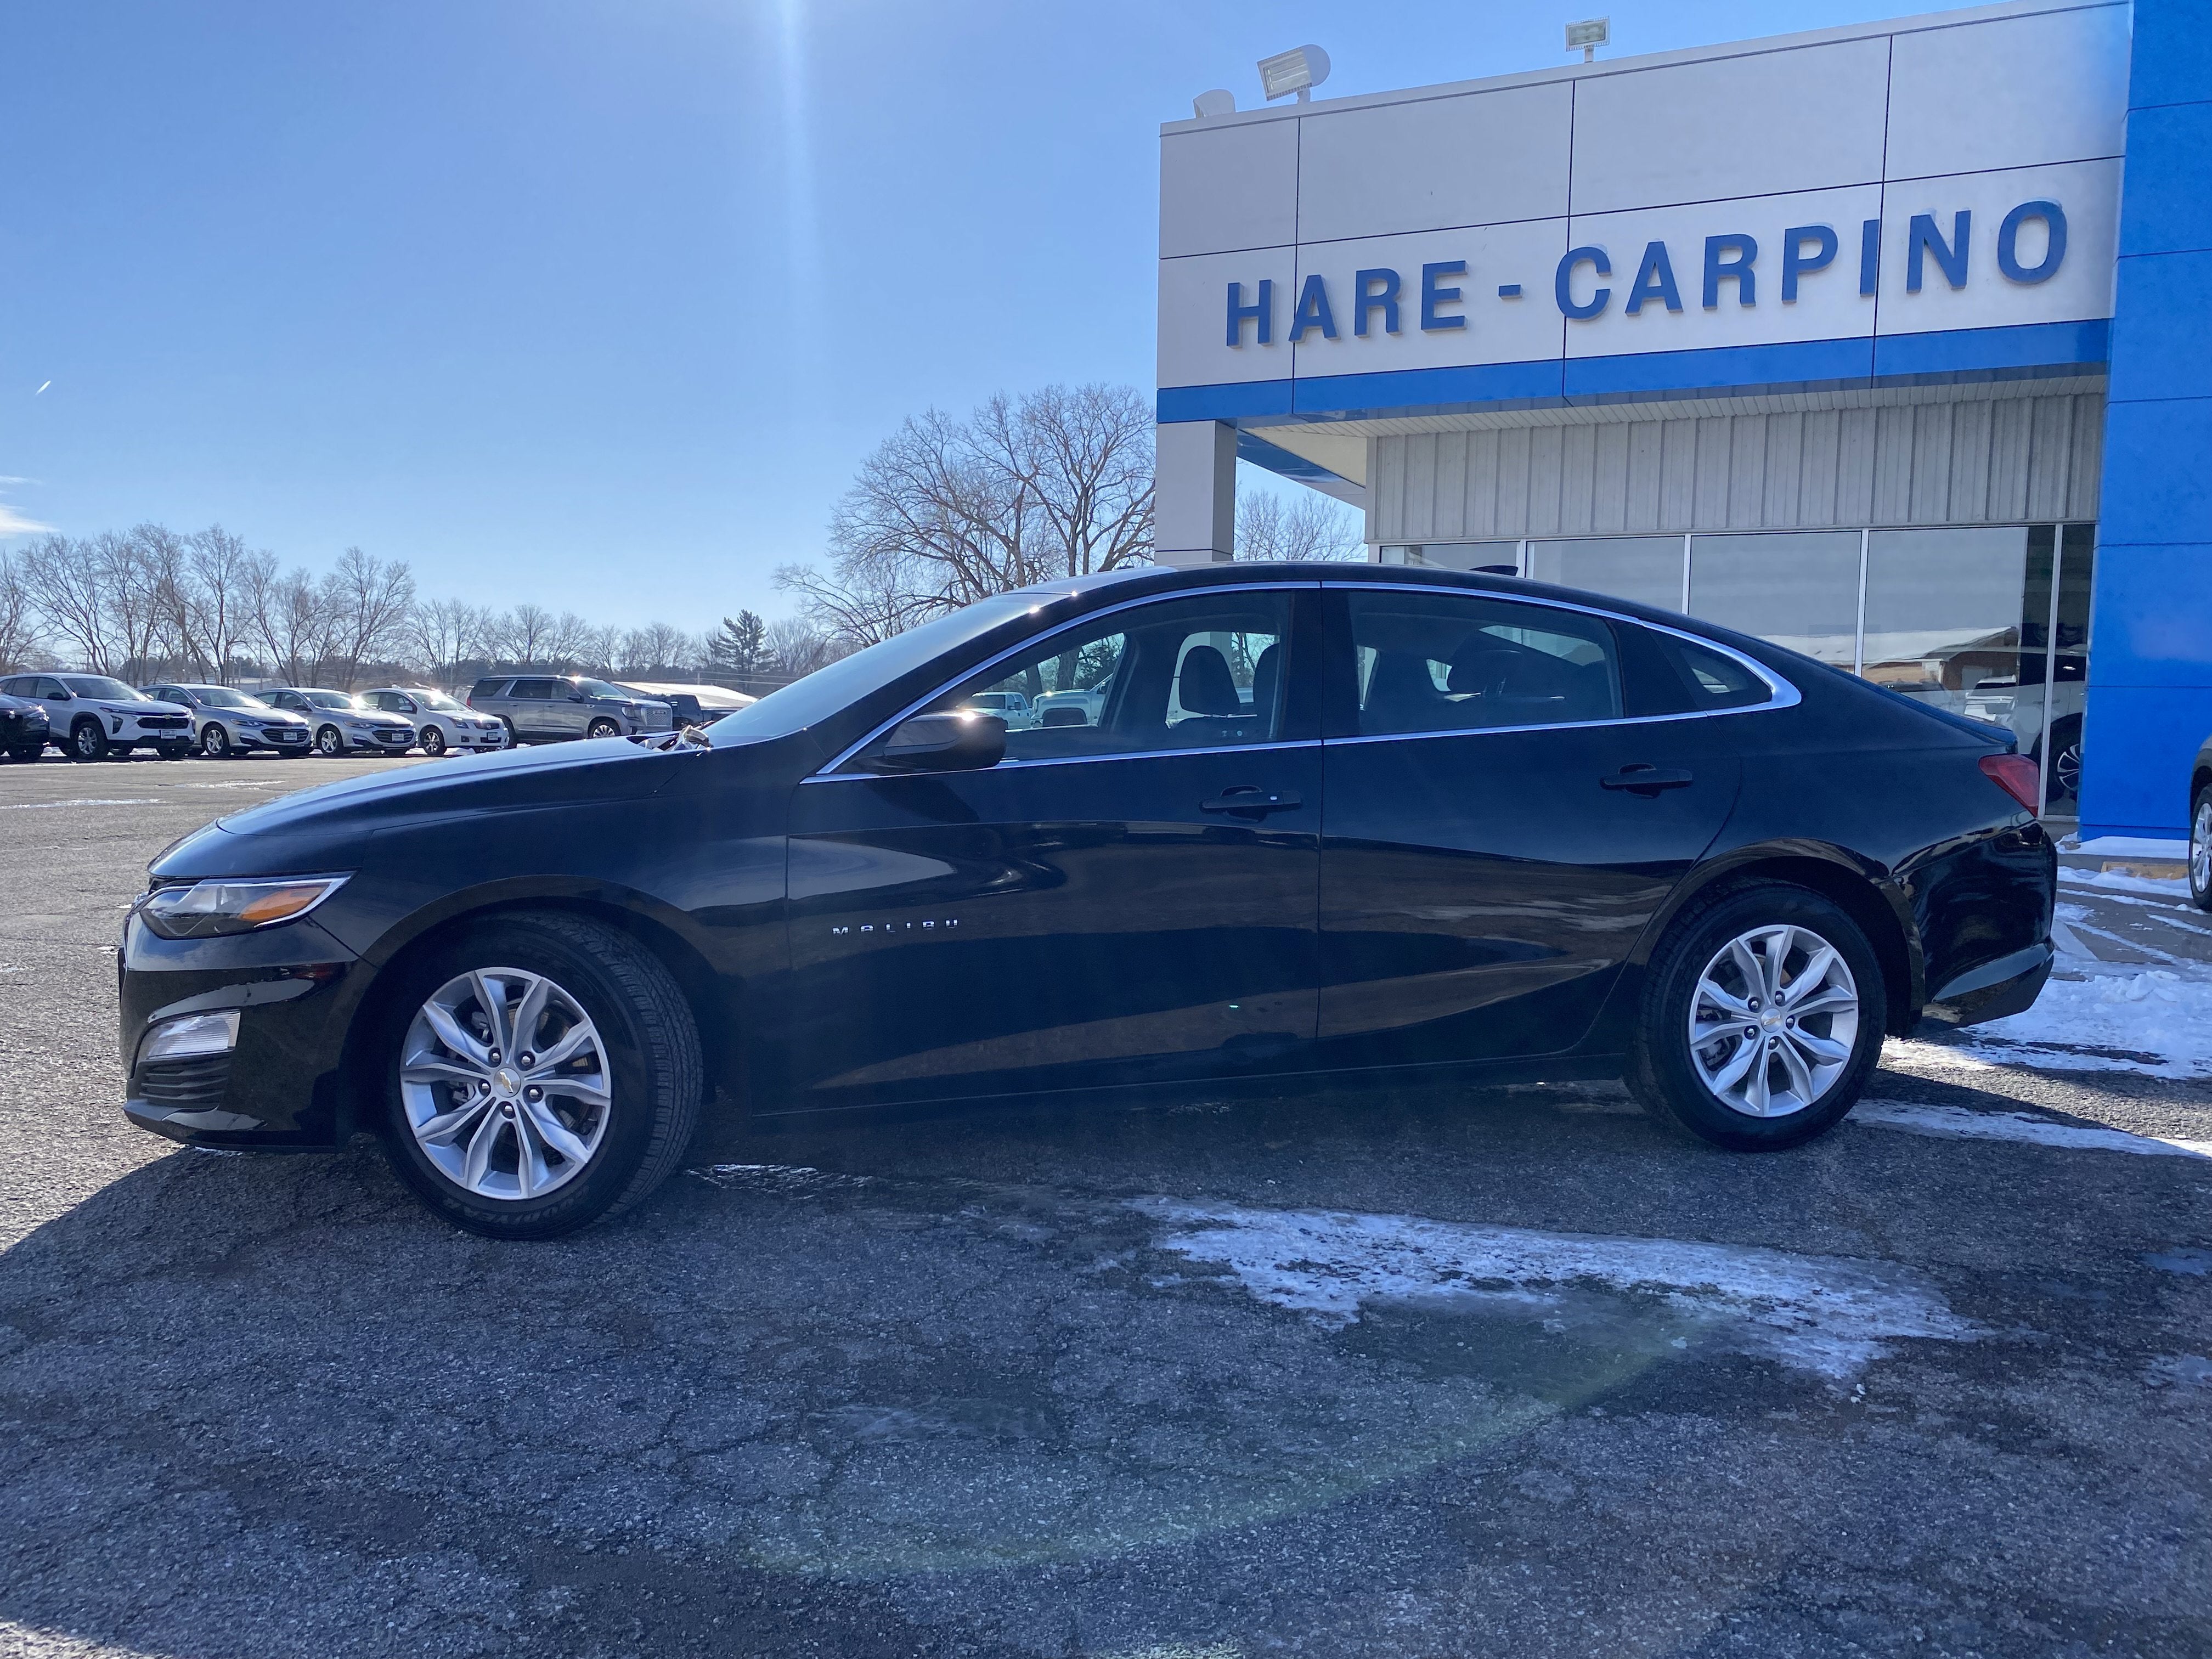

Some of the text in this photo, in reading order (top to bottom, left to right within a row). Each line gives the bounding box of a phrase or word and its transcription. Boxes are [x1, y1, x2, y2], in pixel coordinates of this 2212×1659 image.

[1227, 260, 1469, 349] HARE
[1555, 200, 2068, 321] CARPINO
[832, 918, 958, 935] MALIBU
